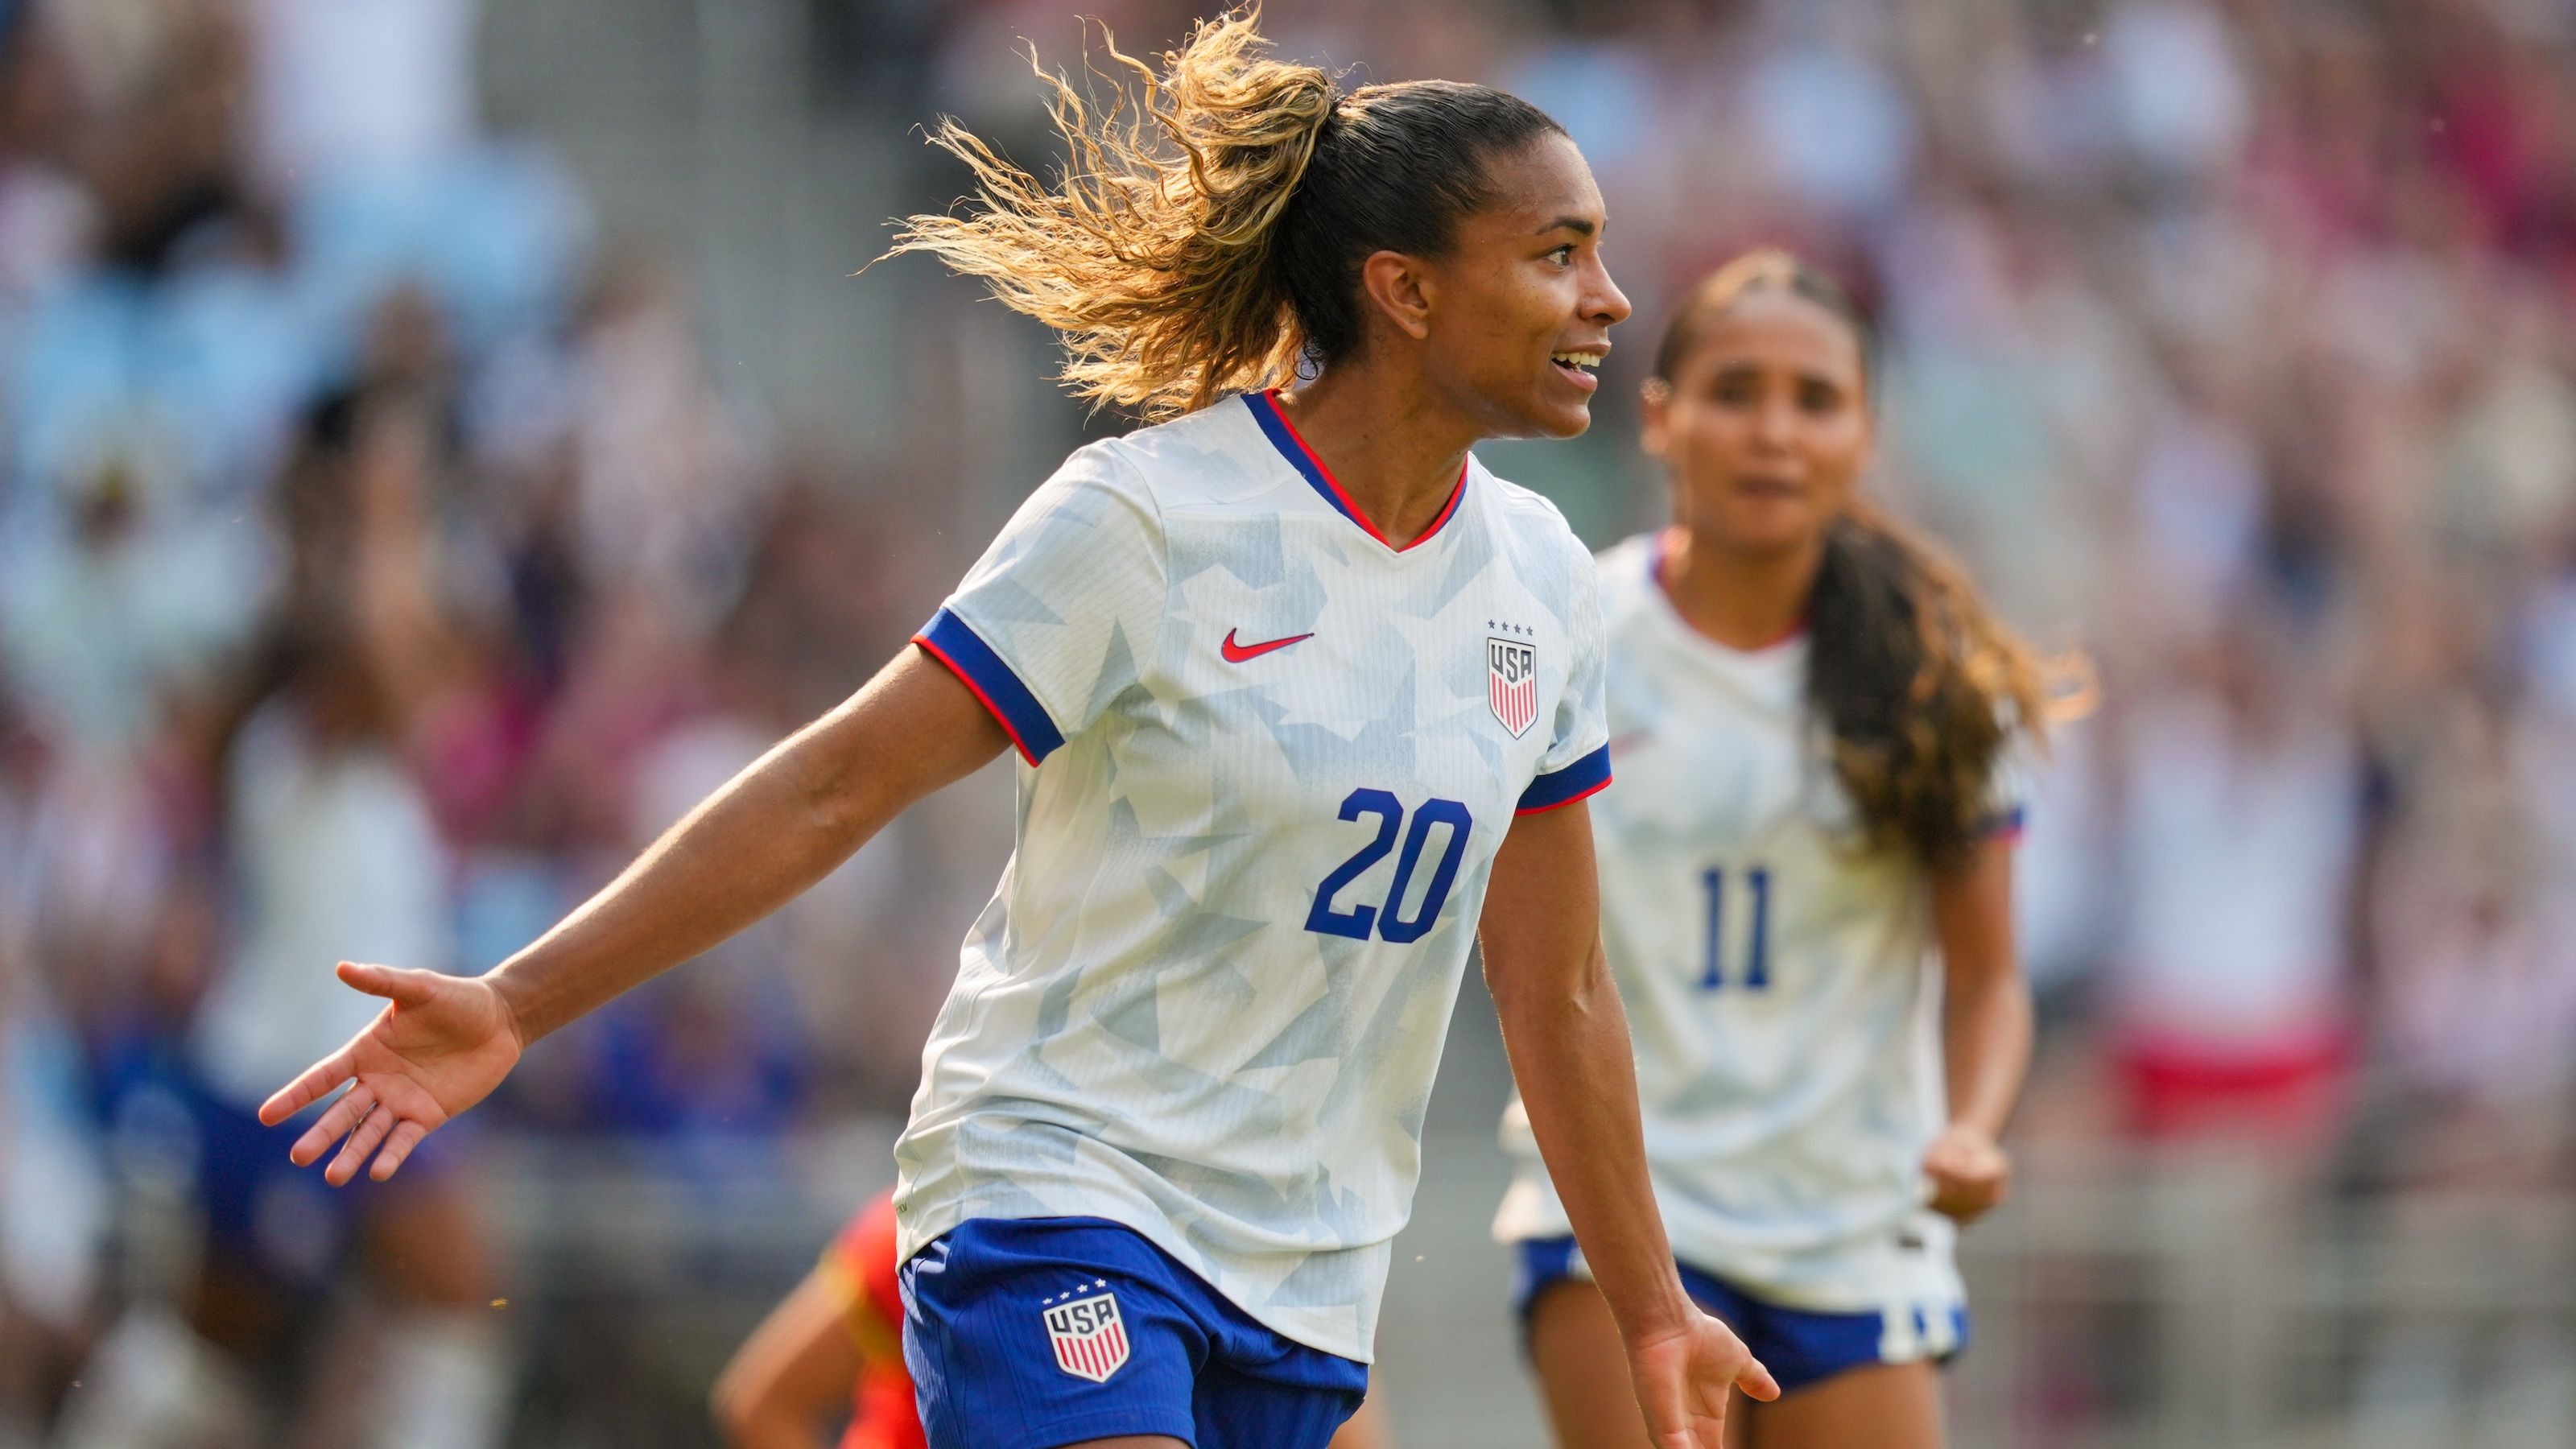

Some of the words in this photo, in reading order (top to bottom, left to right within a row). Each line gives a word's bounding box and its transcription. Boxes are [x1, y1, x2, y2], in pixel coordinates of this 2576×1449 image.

[1491, 644, 1533, 683] USA
[1303, 787, 1473, 944] 20
[1700, 867, 1770, 990] 11
[1049, 1298, 1115, 1335] USA
